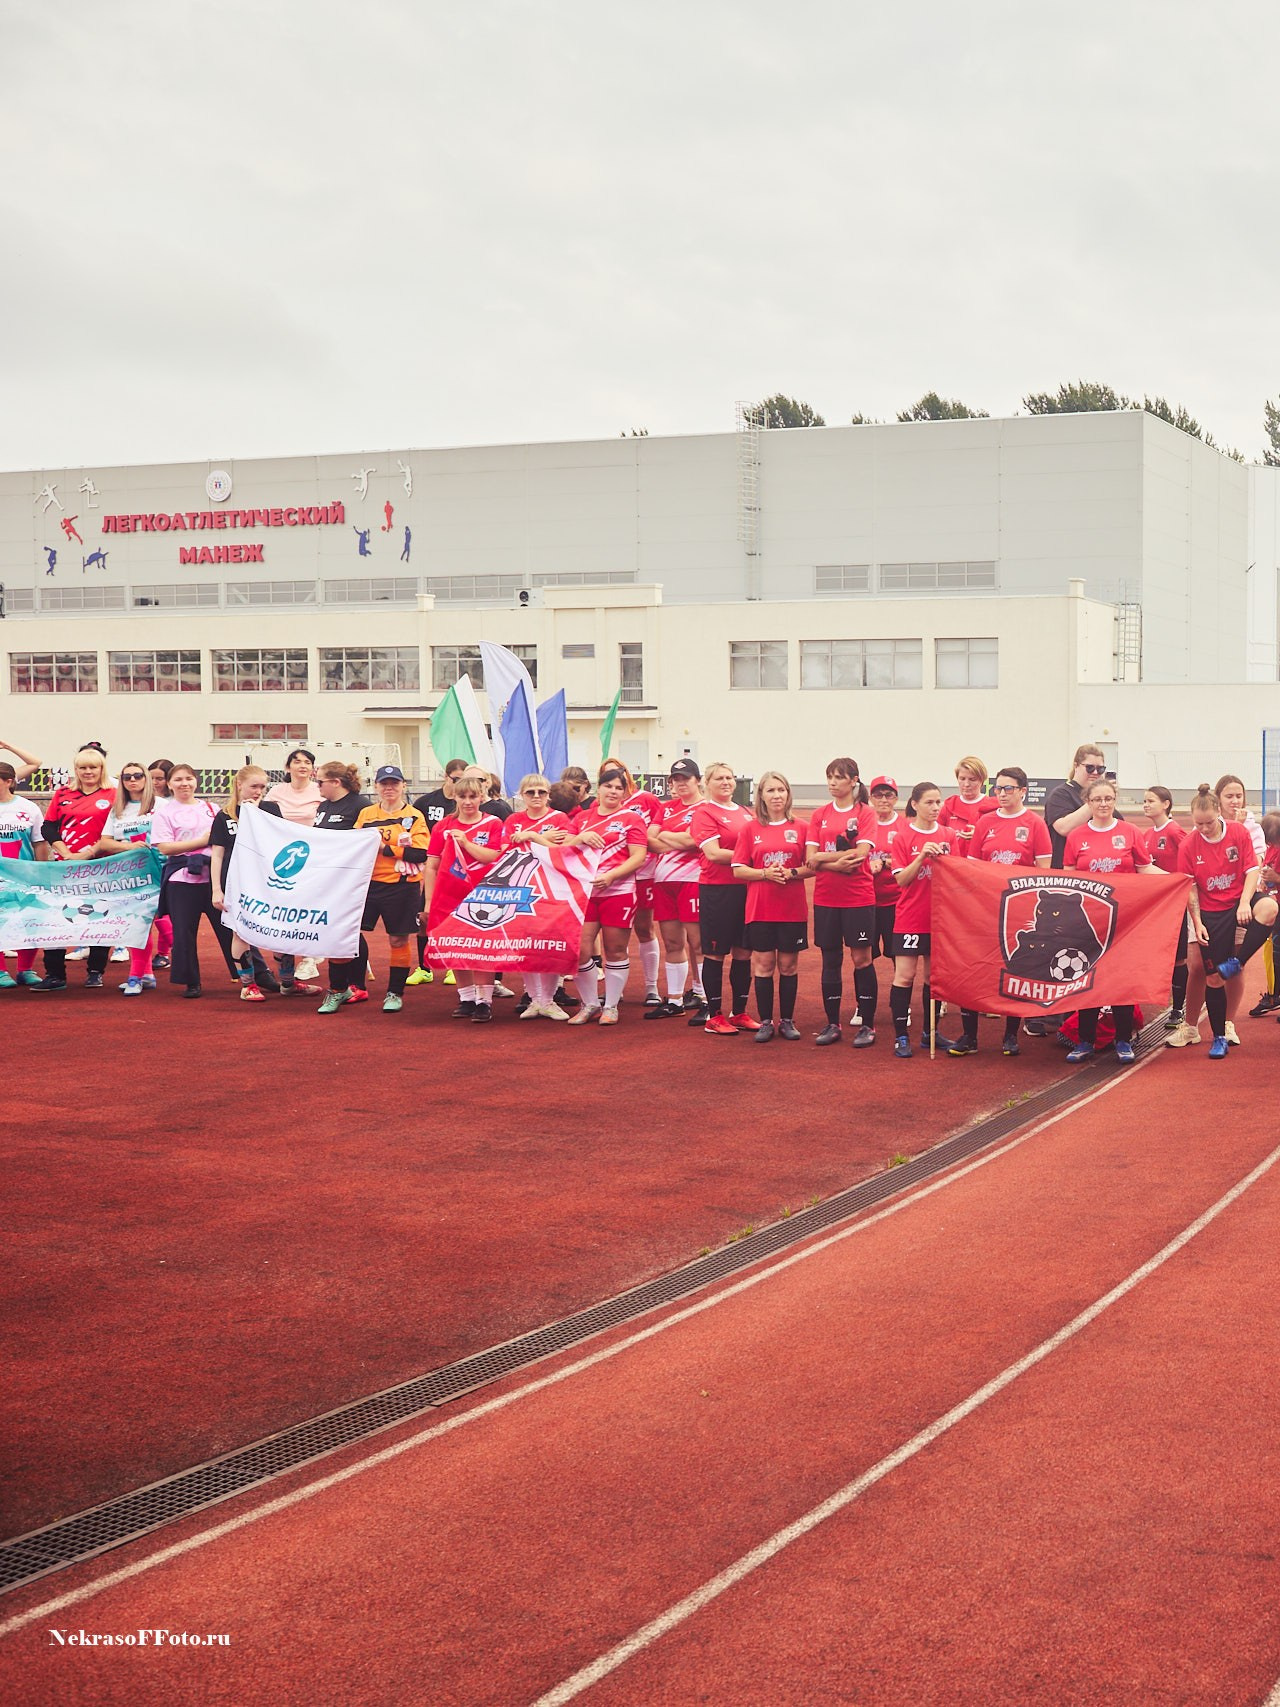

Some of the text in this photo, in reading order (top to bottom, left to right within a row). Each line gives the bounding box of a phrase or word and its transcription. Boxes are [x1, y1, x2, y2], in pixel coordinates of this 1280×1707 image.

[102, 501, 345, 533] ЛЕГКОАТЛЕТИЧЕСКИЙ
[179, 544, 264, 564] МАНЕЖ
[428, 806, 445, 821] 59
[62, 855, 149, 879] ЗАВОЛЖЬЕ
[94, 873, 153, 894] МАМЫ
[1010, 876, 1112, 899] ВЛАДИМИРСКИЕ
[271, 905, 329, 926] СПОРТА
[280, 928, 320, 942] РАЙОНА
[438, 936, 482, 949] ПОБЕДЫ
[483, 939, 492, 949] В
[492, 937, 533, 950] КАЖДОЙ
[533, 939, 567, 951] ИГРЕ!
[903, 934, 920, 949] 22
[1007, 975, 1089, 1000] ПАНТЕРЫ
